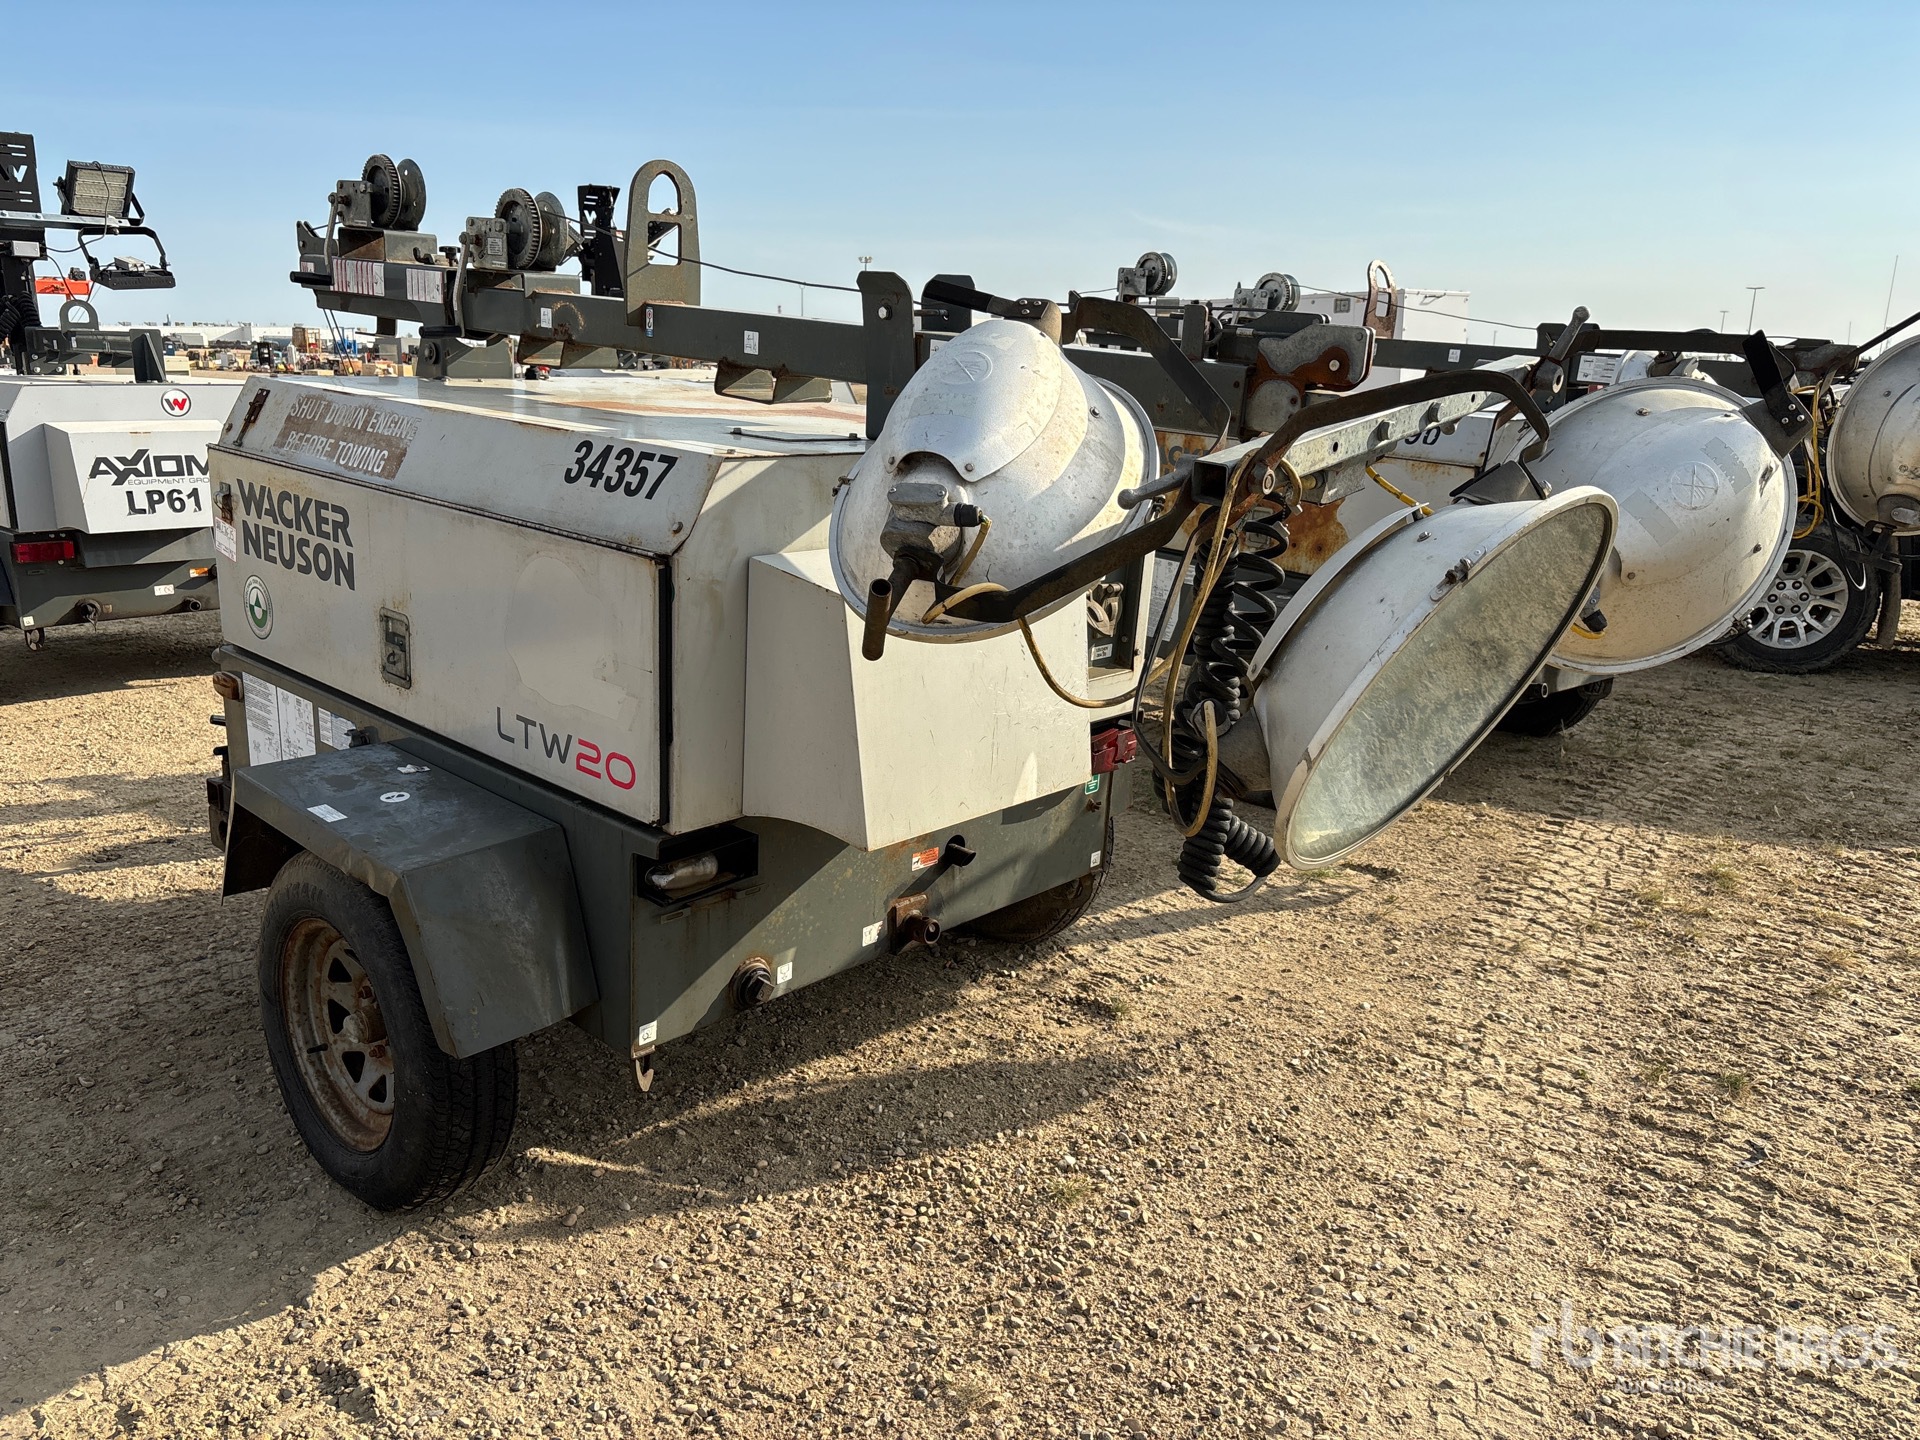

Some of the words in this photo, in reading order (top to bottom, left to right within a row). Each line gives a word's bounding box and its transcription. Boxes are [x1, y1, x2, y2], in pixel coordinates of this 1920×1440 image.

[290, 396, 329, 421] SHUT
[325, 402, 369, 430] DOWN
[366, 411, 422, 440] ENGINE
[89, 448, 210, 486] AXIOM
[284, 431, 335, 460] BEFORE
[333, 441, 389, 474] TOWING
[564, 440, 679, 500] 34357
[125, 487, 202, 516] LP61
[127, 477, 185, 486] EQUIPMENT
[236, 478, 353, 548] WACKER
[242, 519, 355, 591] NEUSON
[497, 706, 636, 790] LTW20
